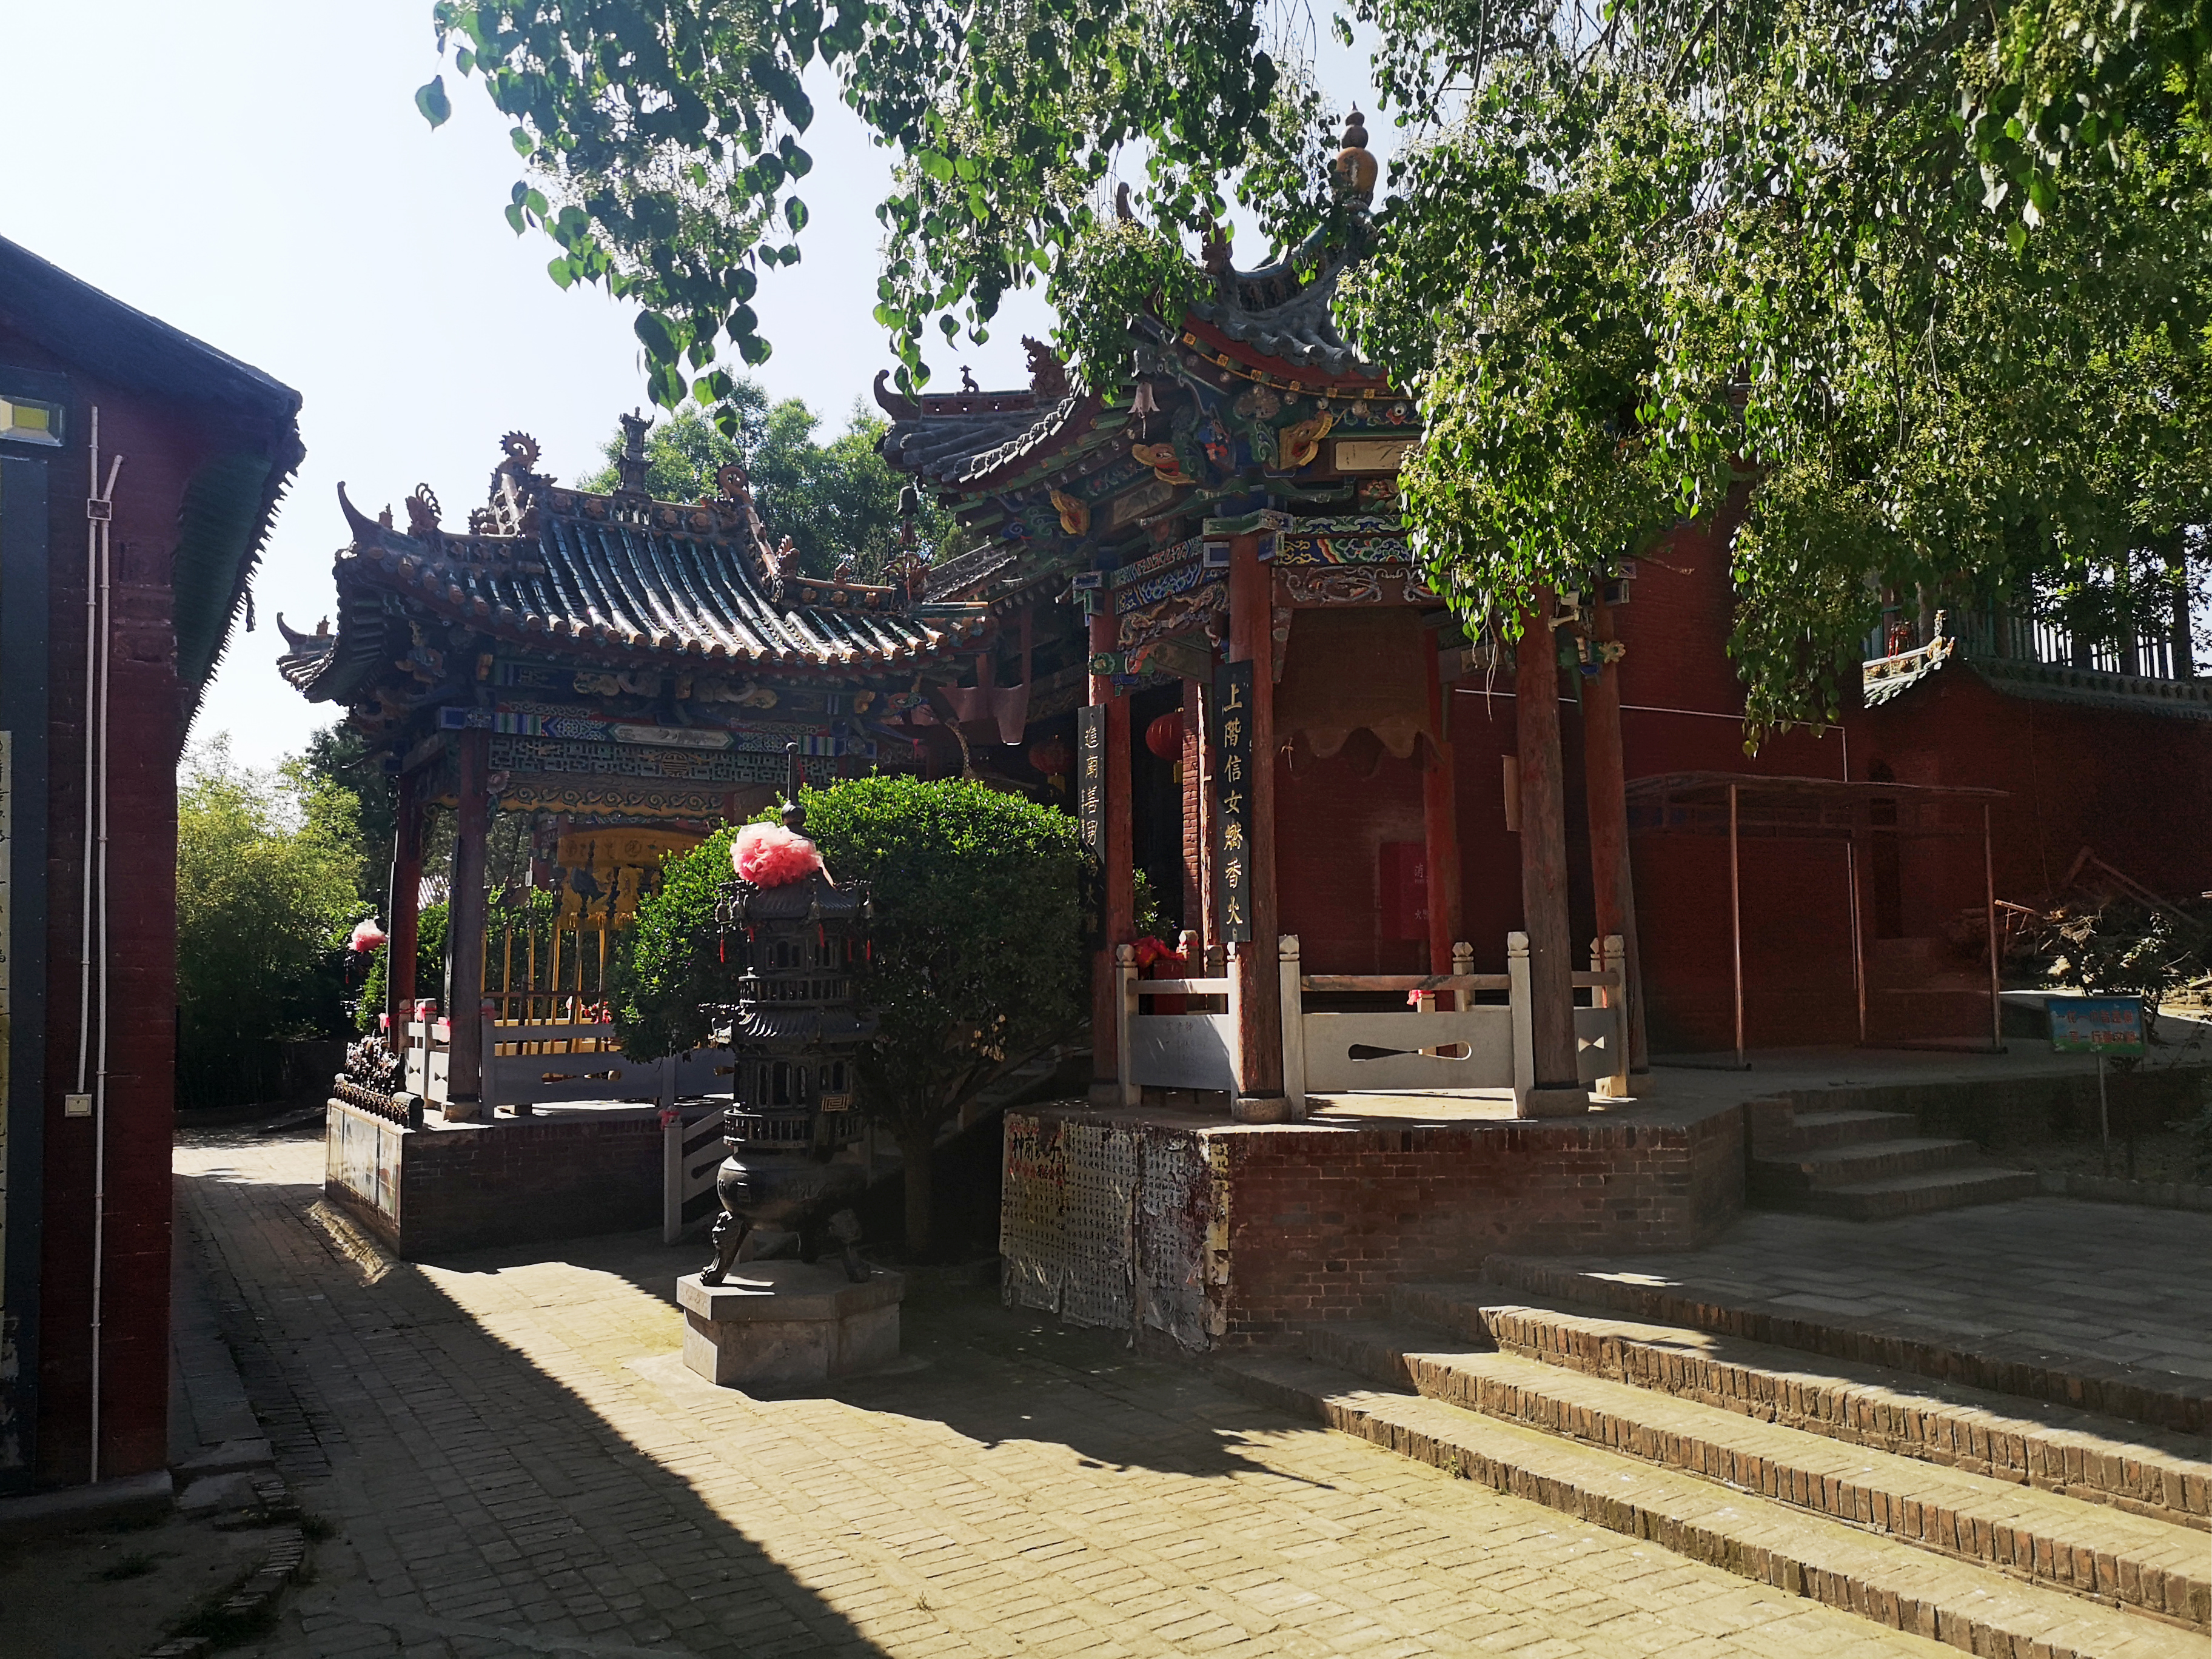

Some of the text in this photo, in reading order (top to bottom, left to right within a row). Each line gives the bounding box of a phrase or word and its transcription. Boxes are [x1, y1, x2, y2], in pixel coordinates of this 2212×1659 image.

[1223, 683, 1243, 925] 上階信女燃香火
